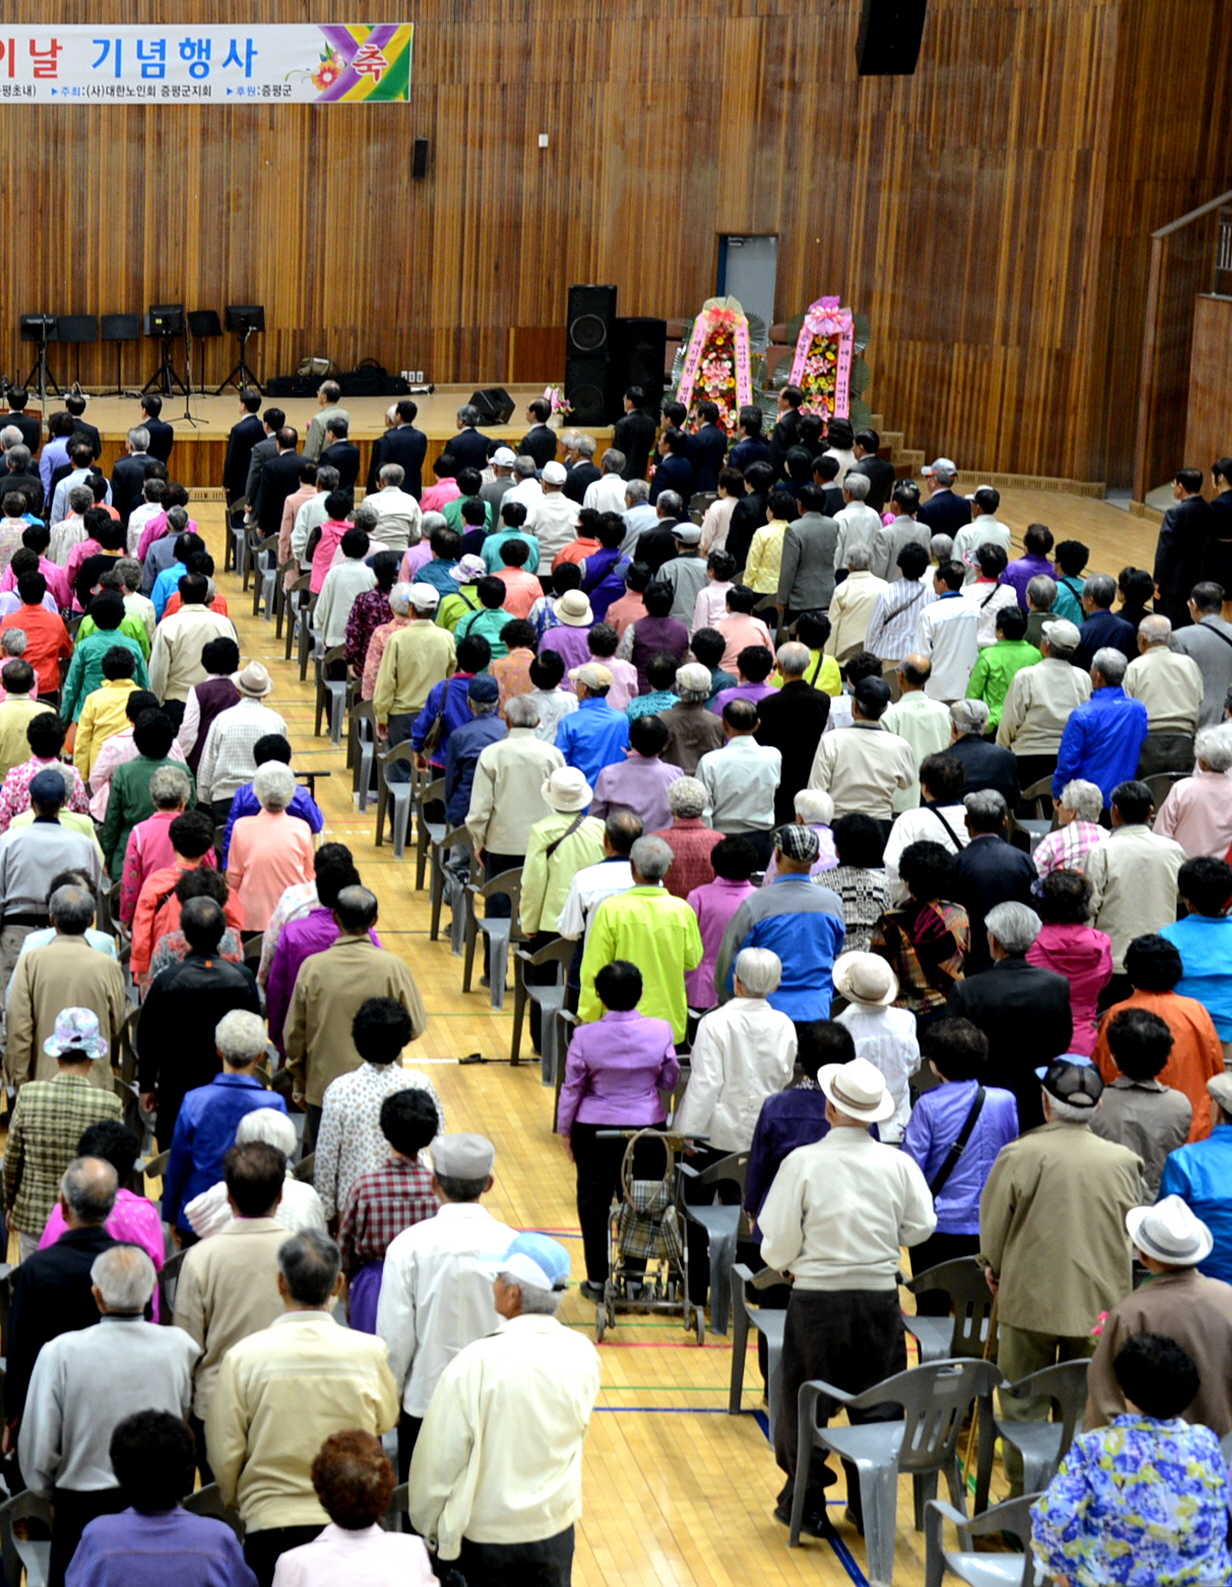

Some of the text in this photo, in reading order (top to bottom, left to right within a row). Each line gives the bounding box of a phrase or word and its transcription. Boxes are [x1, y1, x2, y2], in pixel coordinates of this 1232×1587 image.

[91, 37, 259, 79] 기념행사
[352, 45, 388, 82] 축
[161, 85, 212, 98] 증평군지회
